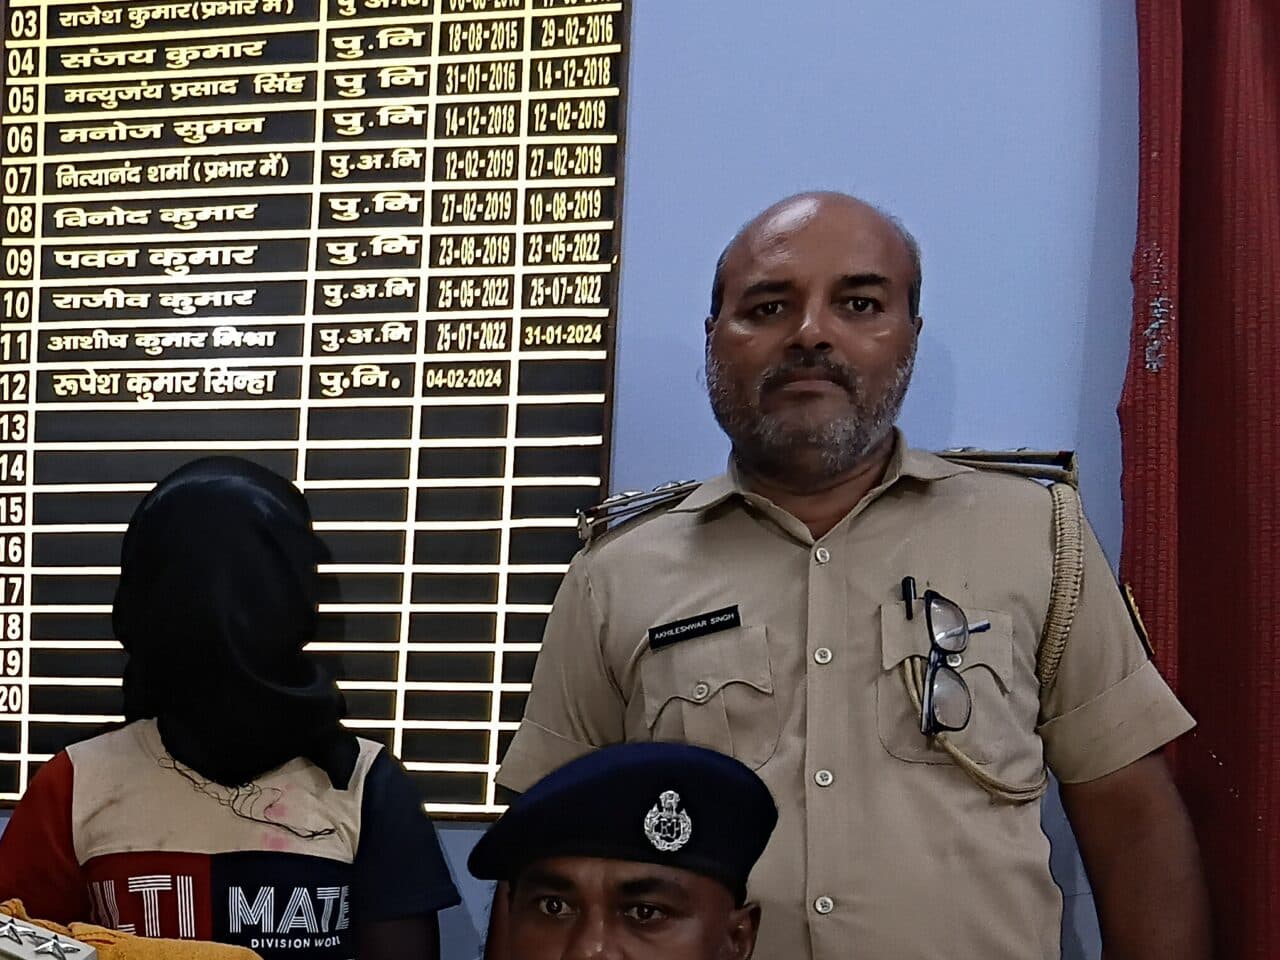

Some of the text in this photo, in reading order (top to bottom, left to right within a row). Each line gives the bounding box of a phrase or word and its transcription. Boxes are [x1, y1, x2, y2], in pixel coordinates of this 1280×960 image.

[10, 10, 38, 37] 03
[59, 6, 122, 27] राजेश
[8, 48, 34, 76] 04
[60, 48, 157, 69] संजय
[164, 40, 267, 69] कुमार
[448, 21, 518, 52] 18-08-2015
[541, 14, 613, 47] 29-02-2016
[8, 86, 34, 114] 05
[170, 79, 239, 101] प्रसाद
[253, 72, 306, 95] सिंह
[445, 62, 516, 94] 31-01-2016
[538, 57, 611, 89] 14-12-2018
[6, 126, 33, 154] 06
[59, 121, 164, 144] मनोज
[173, 117, 265, 145] सुमन
[445, 105, 515, 136] 14-12-2018
[534, 100, 606, 132] 12-02-2019
[4, 167, 32, 194] 07
[445, 149, 514, 180] 12-02-2019
[530, 145, 602, 177] 27-02-2019
[6, 206, 33, 233] 08
[53, 206, 151, 229] विनोद
[159, 203, 258, 230] कुमार
[441, 191, 512, 223] 27-02-2019
[529, 189, 602, 222] 10-08-2019
[6, 248, 32, 276] 09
[53, 248, 139, 270] पवन
[148, 245, 258, 277] कुमार
[438, 235, 510, 266] 23-08-2019
[528, 233, 600, 263] 23-05-2022
[3, 290, 30, 318] 10
[52, 288, 151, 309] राजीव
[158, 289, 257, 316] कुमार
[438, 277, 509, 308] 25-05-2022
[530, 275, 601, 306] 25-07-2022
[0, 333, 28, 361] 11
[47, 329, 129, 351] आशीष
[135, 331, 209, 356] कुमार
[436, 322, 507, 351] 25-07-2022
[524, 324, 602, 346] 31-01-2024
[0, 374, 26, 401] 12
[52, 369, 120, 396] रूपेश
[126, 371, 200, 403] कुमार
[202, 367, 277, 394] सिन्हा
[426, 368, 502, 389] 04-02-2024
[0, 415, 25, 441] 13
[710, 613, 735, 625] SINGH
[251, 937, 310, 949] DIVISION
